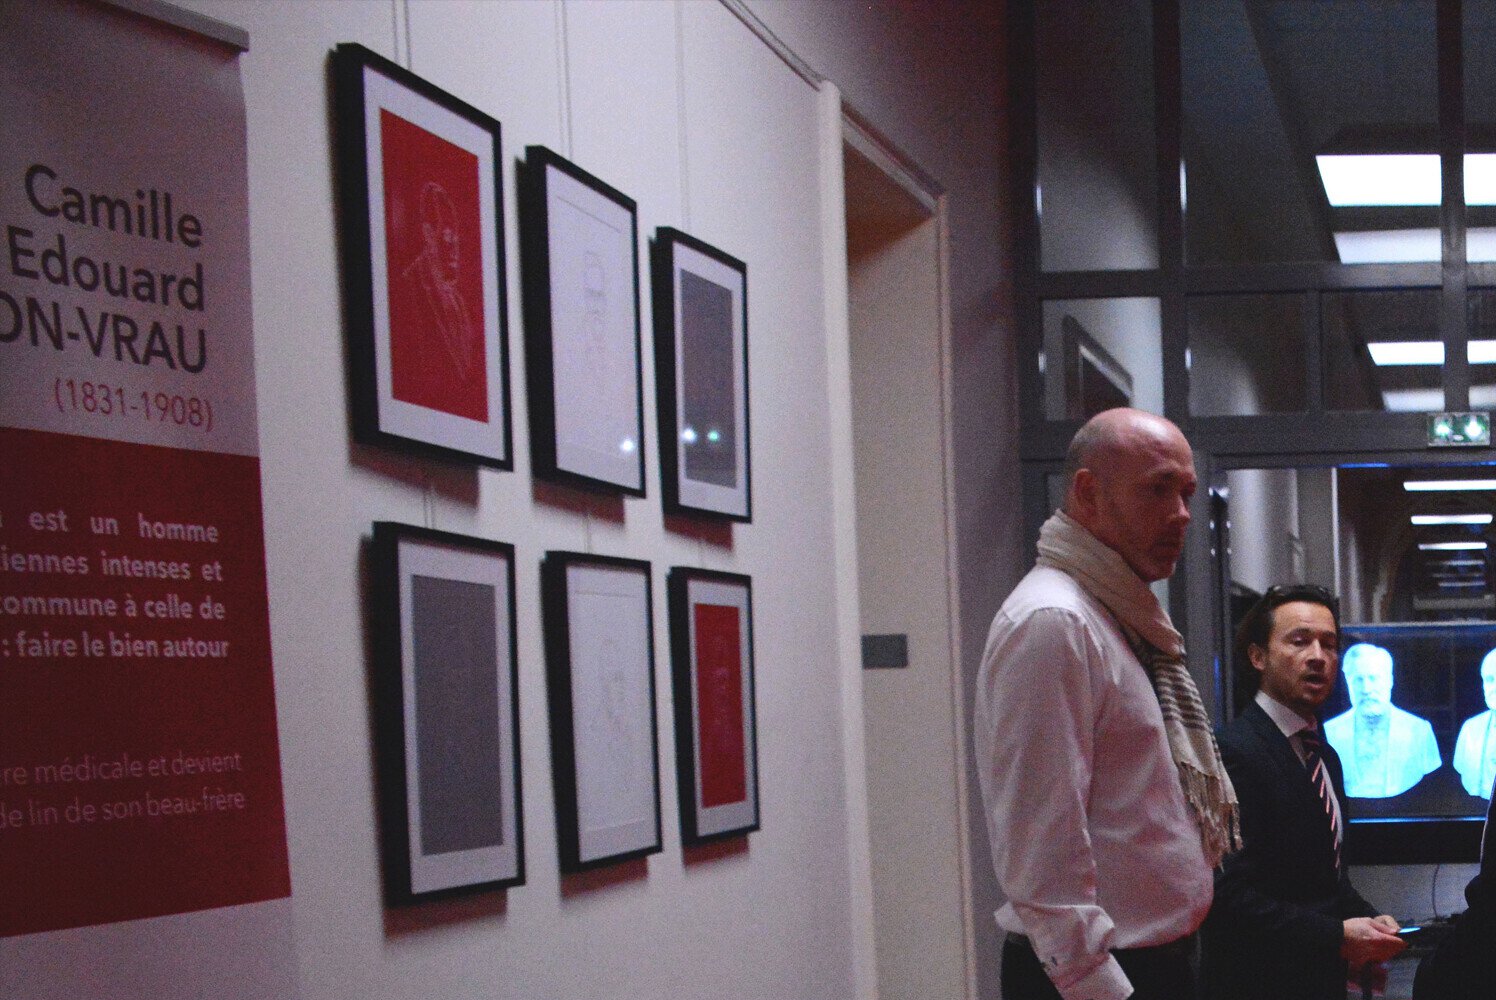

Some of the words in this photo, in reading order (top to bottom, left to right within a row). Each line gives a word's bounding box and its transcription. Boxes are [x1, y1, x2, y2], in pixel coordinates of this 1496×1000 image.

[24, 164, 202, 248] Camille
[7, 225, 204, 311] Edouard
[55, 377, 213, 432] (1831-1908)
[29, 510, 69, 532] est
[90, 516, 119, 535] un
[138, 512, 219, 543] homme
[0, 545, 89, 574] iennes
[101, 550, 191, 580] intenses
[202, 561, 223, 581] et
[0, 596, 118, 616] ommune
[125, 593, 137, 617] à
[144, 593, 193, 619] celle
[200, 595, 226, 620] de
[16, 630, 77, 657] faire
[82, 631, 105, 657] le
[109, 631, 158, 657] bien
[163, 637, 229, 658] autour
[35, 753, 143, 784] médicale
[149, 758, 169, 777] et
[172, 750, 242, 776] devient
[28, 799, 57, 826] lin
[65, 796, 97, 823] de
[103, 801, 142, 821] son
[146, 786, 245, 817] beau-frère
